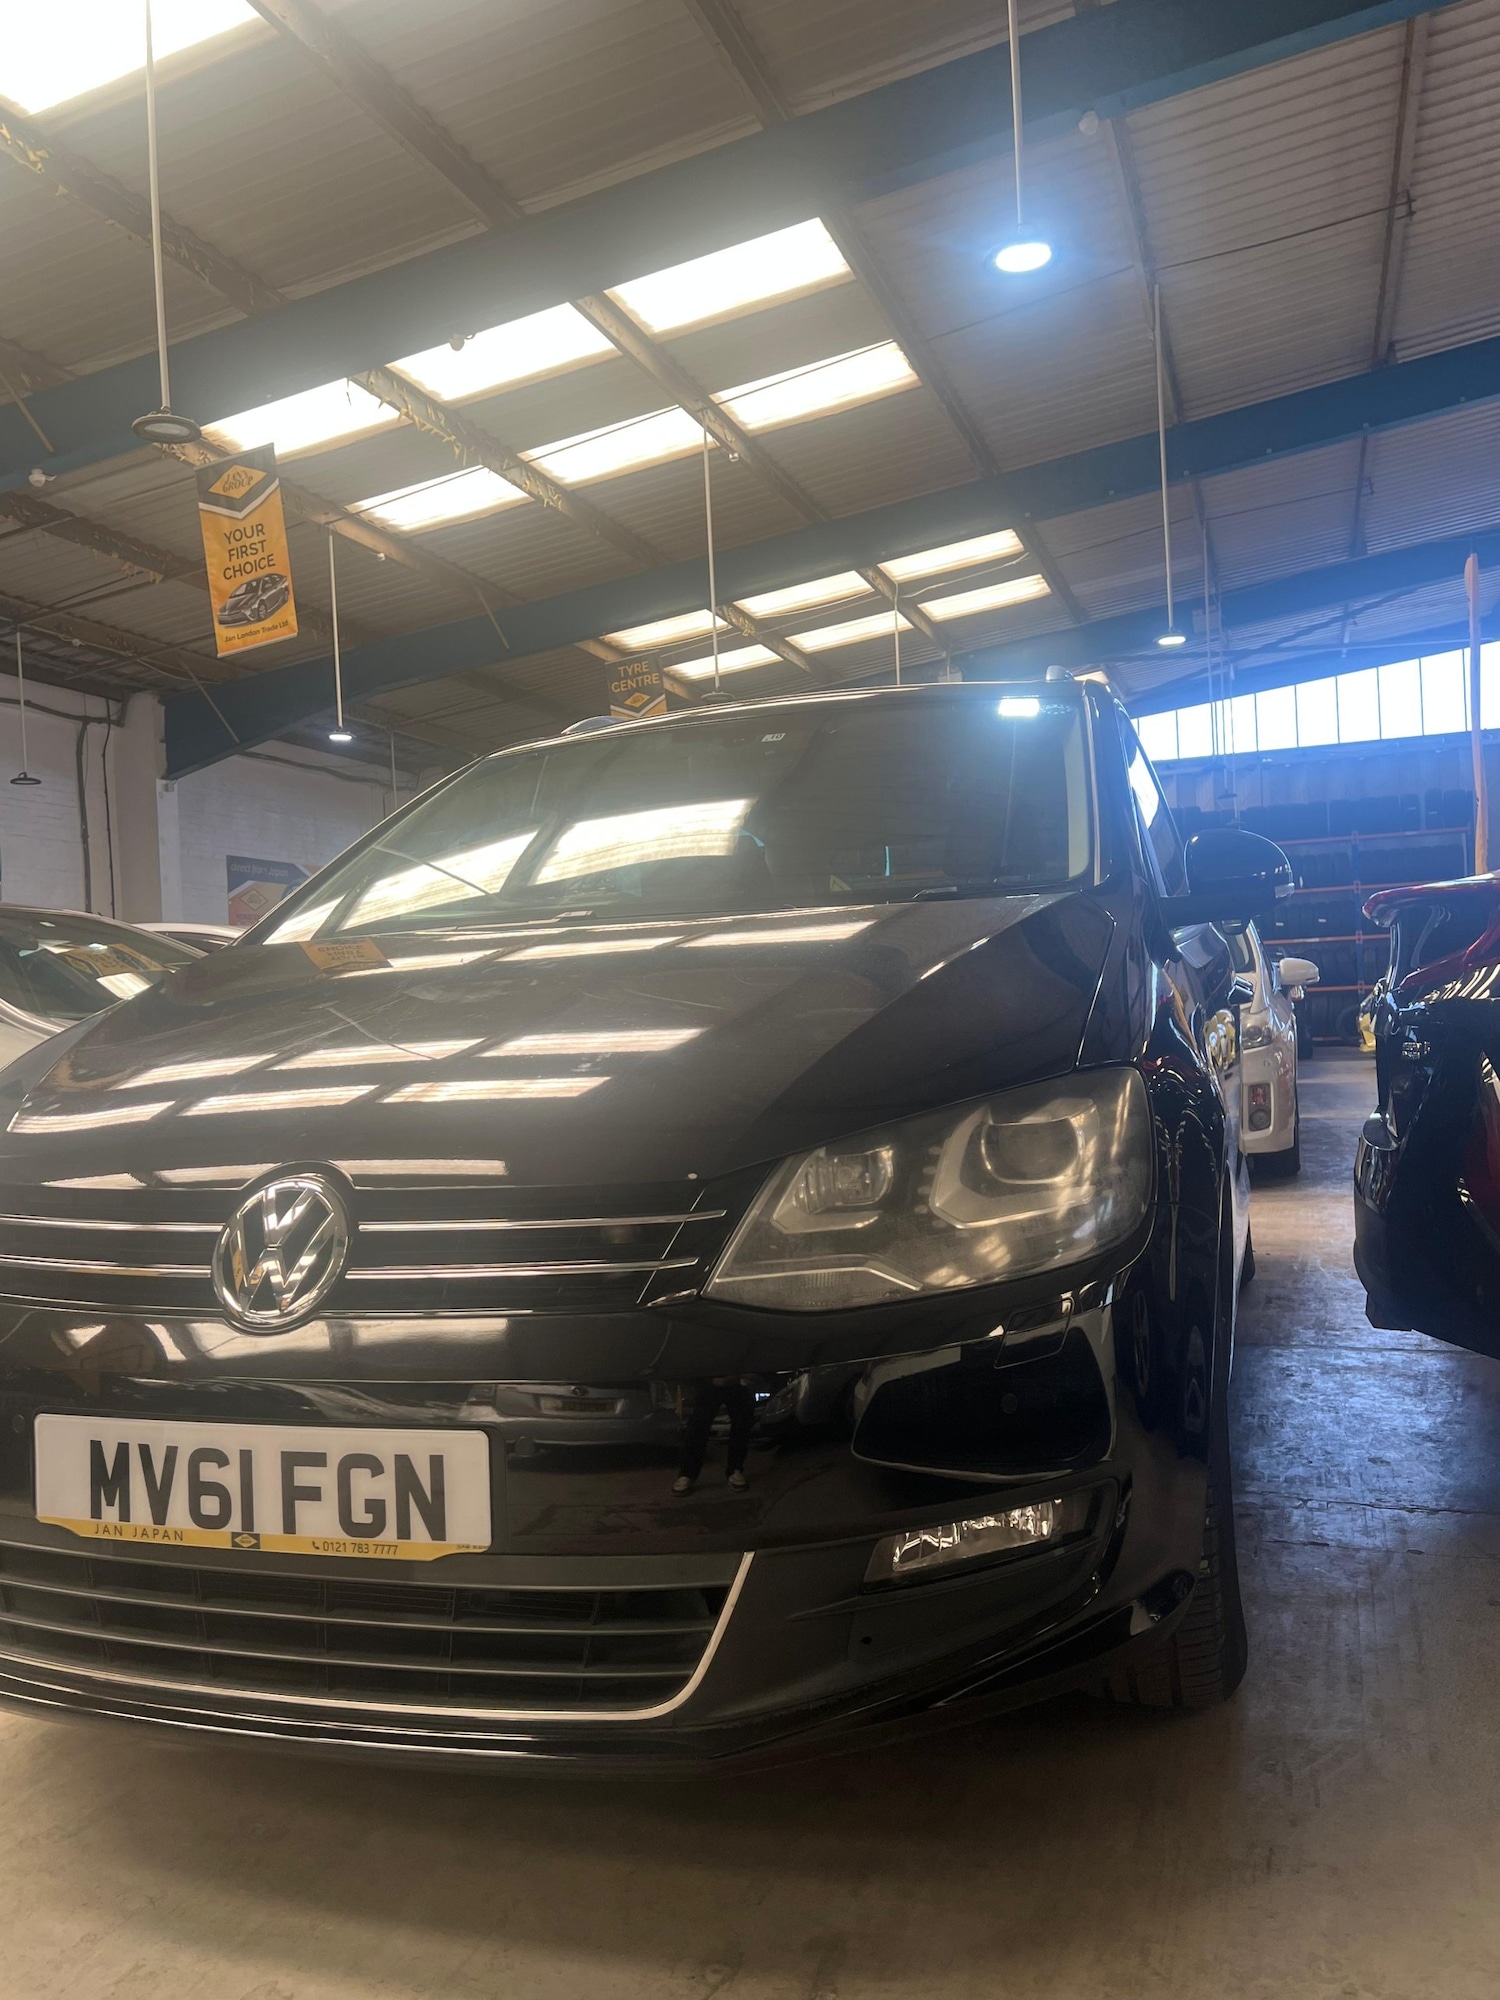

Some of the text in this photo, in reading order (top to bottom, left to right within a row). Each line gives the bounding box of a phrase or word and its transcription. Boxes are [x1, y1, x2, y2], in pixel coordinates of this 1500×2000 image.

[222, 476, 254, 492] GROUP
[223, 523, 265, 545] YOUR
[228, 540, 267, 563] FIRST
[223, 553, 276, 580] CHOICE
[236, 629, 261, 640] London
[261, 624, 279, 633] Trade
[279, 619, 289, 628] Ltd
[617, 661, 649, 677] TYRE
[611, 673, 660, 693] CENTRE
[231, 863, 251, 873] direct
[268, 867, 289, 877] Japan
[90, 1440, 447, 1541] MV61 FGN
[95, 1523, 184, 1542] JAN JAPAN
[322, 1541, 399, 1555] 0121 783 7777
